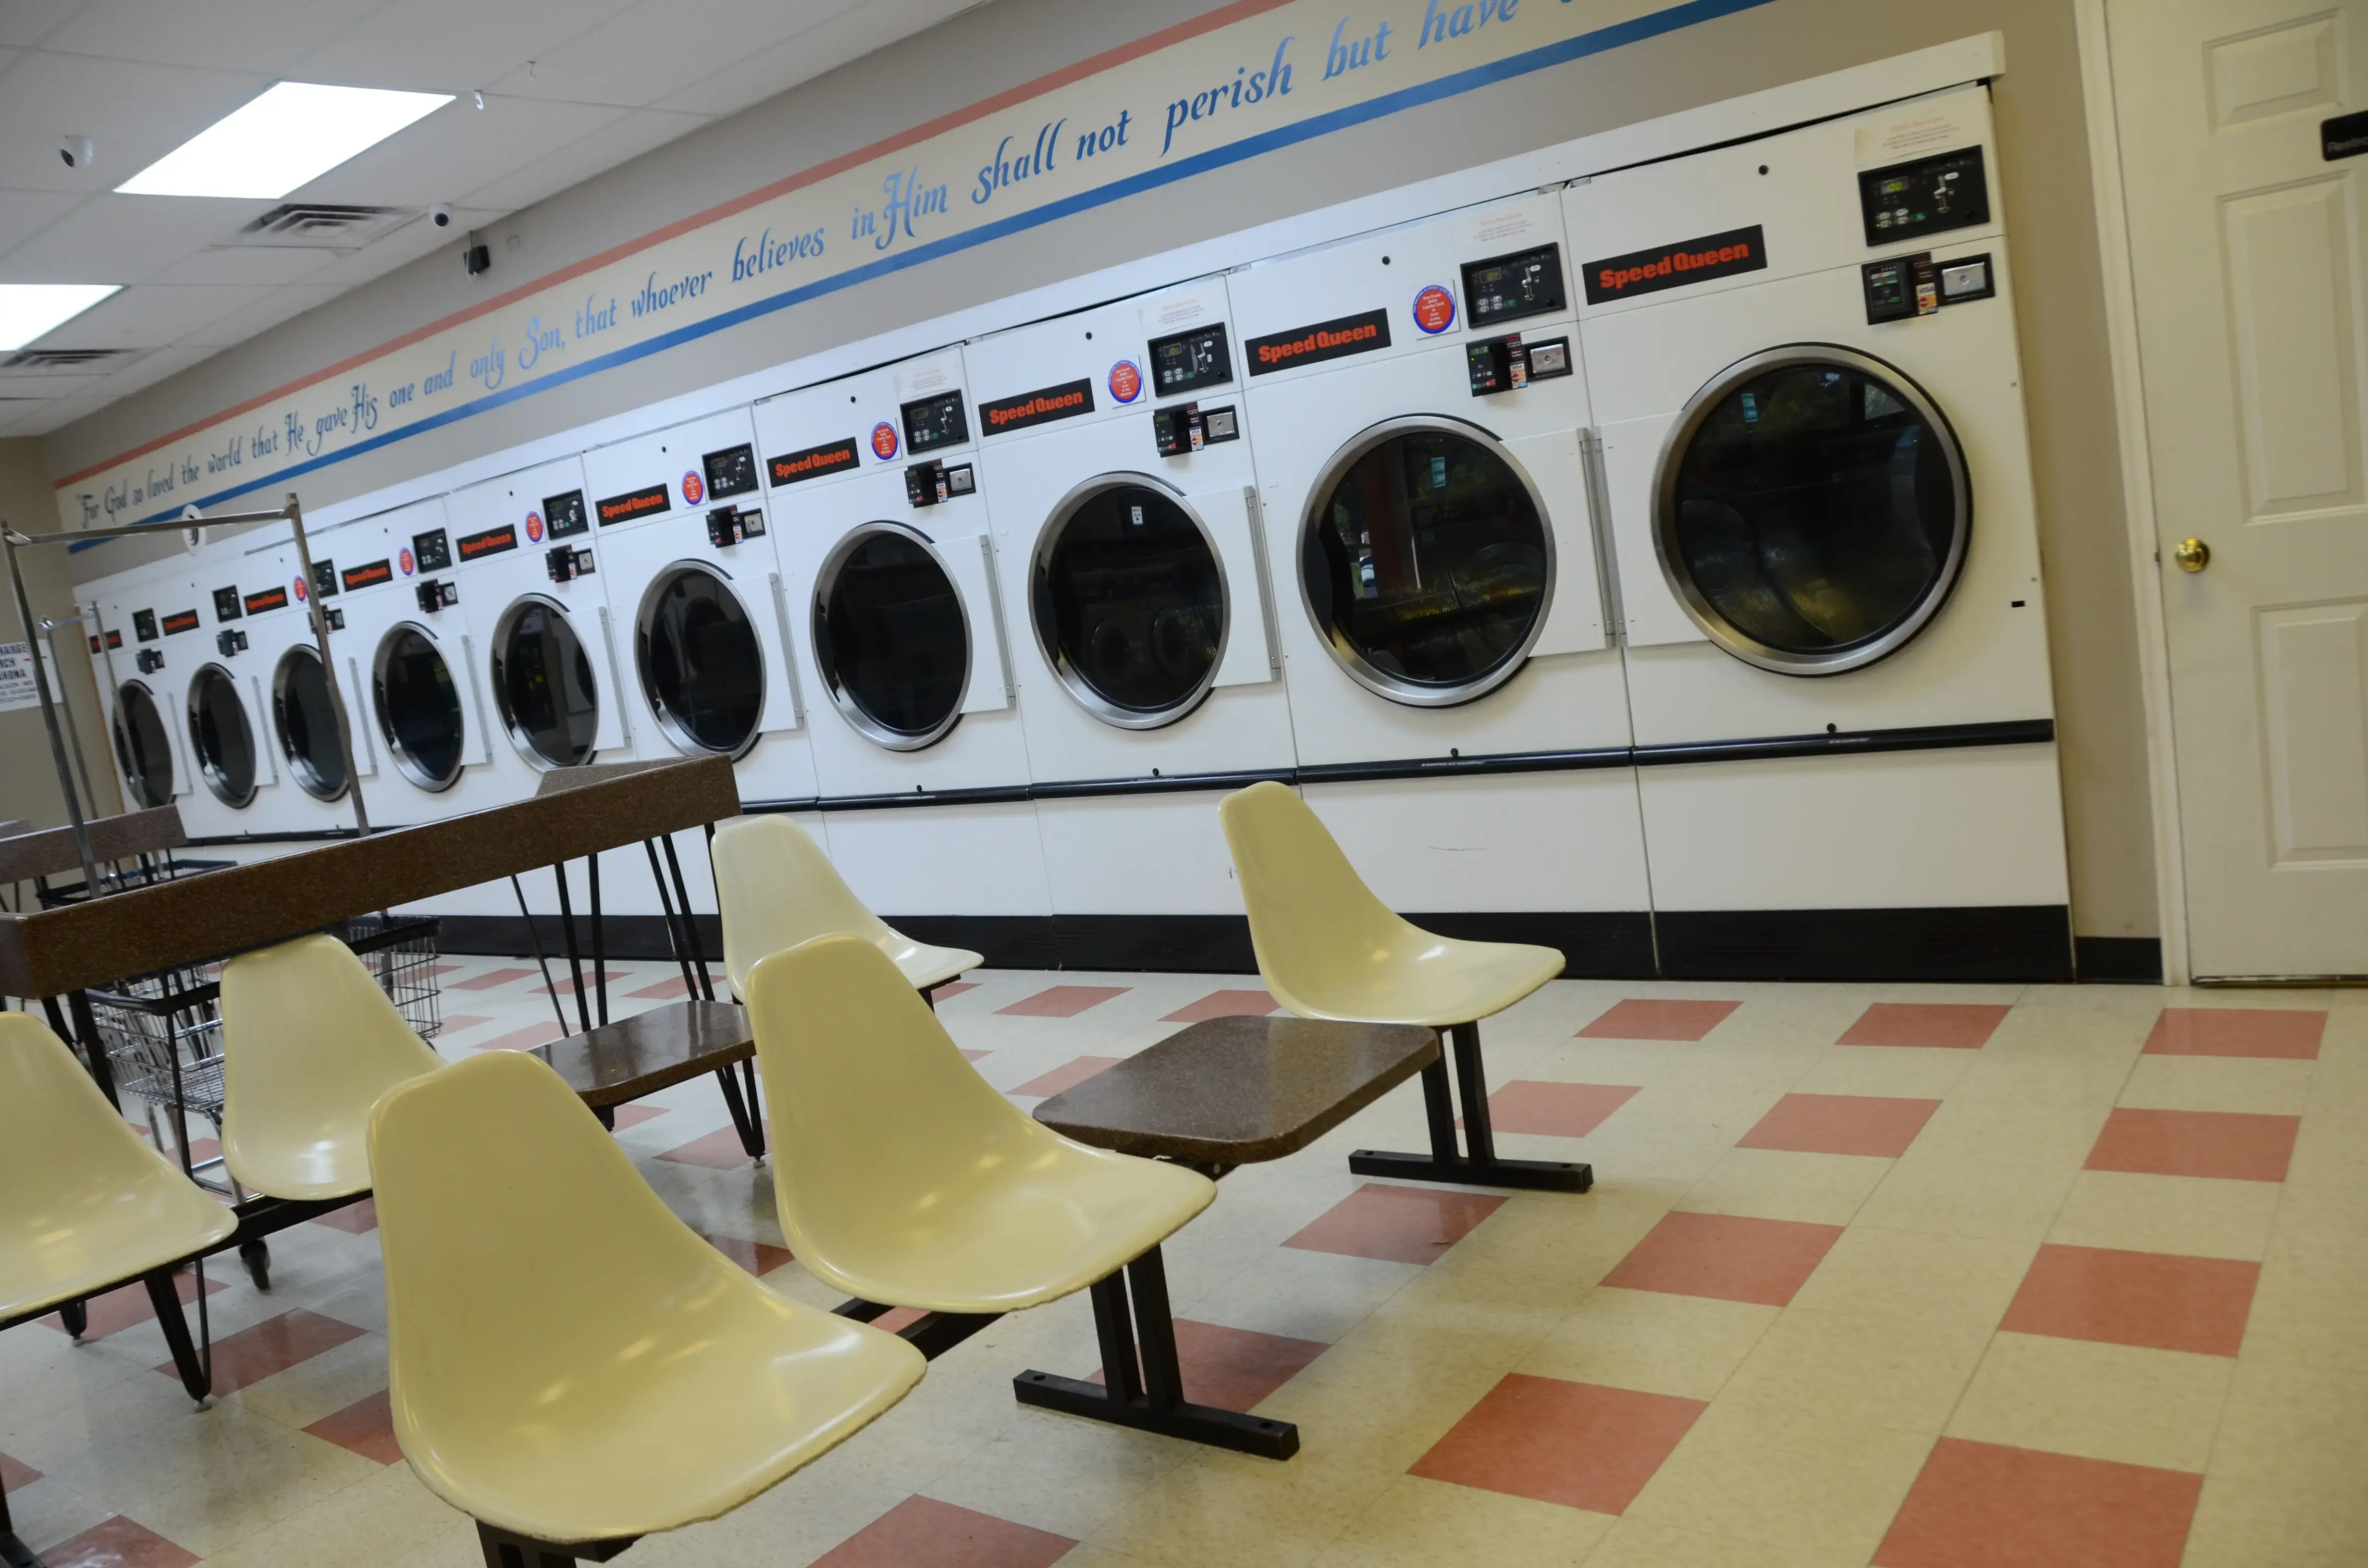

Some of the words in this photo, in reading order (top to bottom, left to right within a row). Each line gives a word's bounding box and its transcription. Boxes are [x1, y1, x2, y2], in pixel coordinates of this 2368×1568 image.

[104, 479, 127, 524] God
[147, 462, 175, 500] loved
[181, 455, 200, 483] the
[208, 435, 241, 474] world
[251, 424, 278, 459] that
[284, 410, 304, 457] He
[306, 405, 348, 456] gave
[350, 382, 378, 434] His
[389, 381, 415, 408] one
[423, 350, 457, 396] and
[469, 335, 505, 390] only
[518, 316, 566, 371] Son,
[574, 294, 617, 339] that
[630, 270, 714, 318] whoever
[730, 227, 826, 283] believes
[851, 206, 877, 241] in
[874, 165, 949, 251] Him
[970, 118, 1069, 205] shall
[1075, 109, 1134, 161] not
[1159, 37, 1294, 158] perish
[1321, 16, 1394, 82] but
[1417, 0, 1520, 50] have
[1599, 256, 1672, 290] Speed
[1673, 244, 1749, 271] Queen
[1258, 334, 1316, 364] Speed
[1316, 324, 1377, 349] Queen
[988, 400, 1036, 425] Speed
[1035, 392, 1084, 413] Queen
[775, 463, 812, 478] Speed
[812, 449, 851, 467] Queen
[602, 500, 632, 519] Speed
[631, 493, 664, 512] Queen
[461, 538, 486, 555] Speed
[485, 533, 512, 549] Queen
